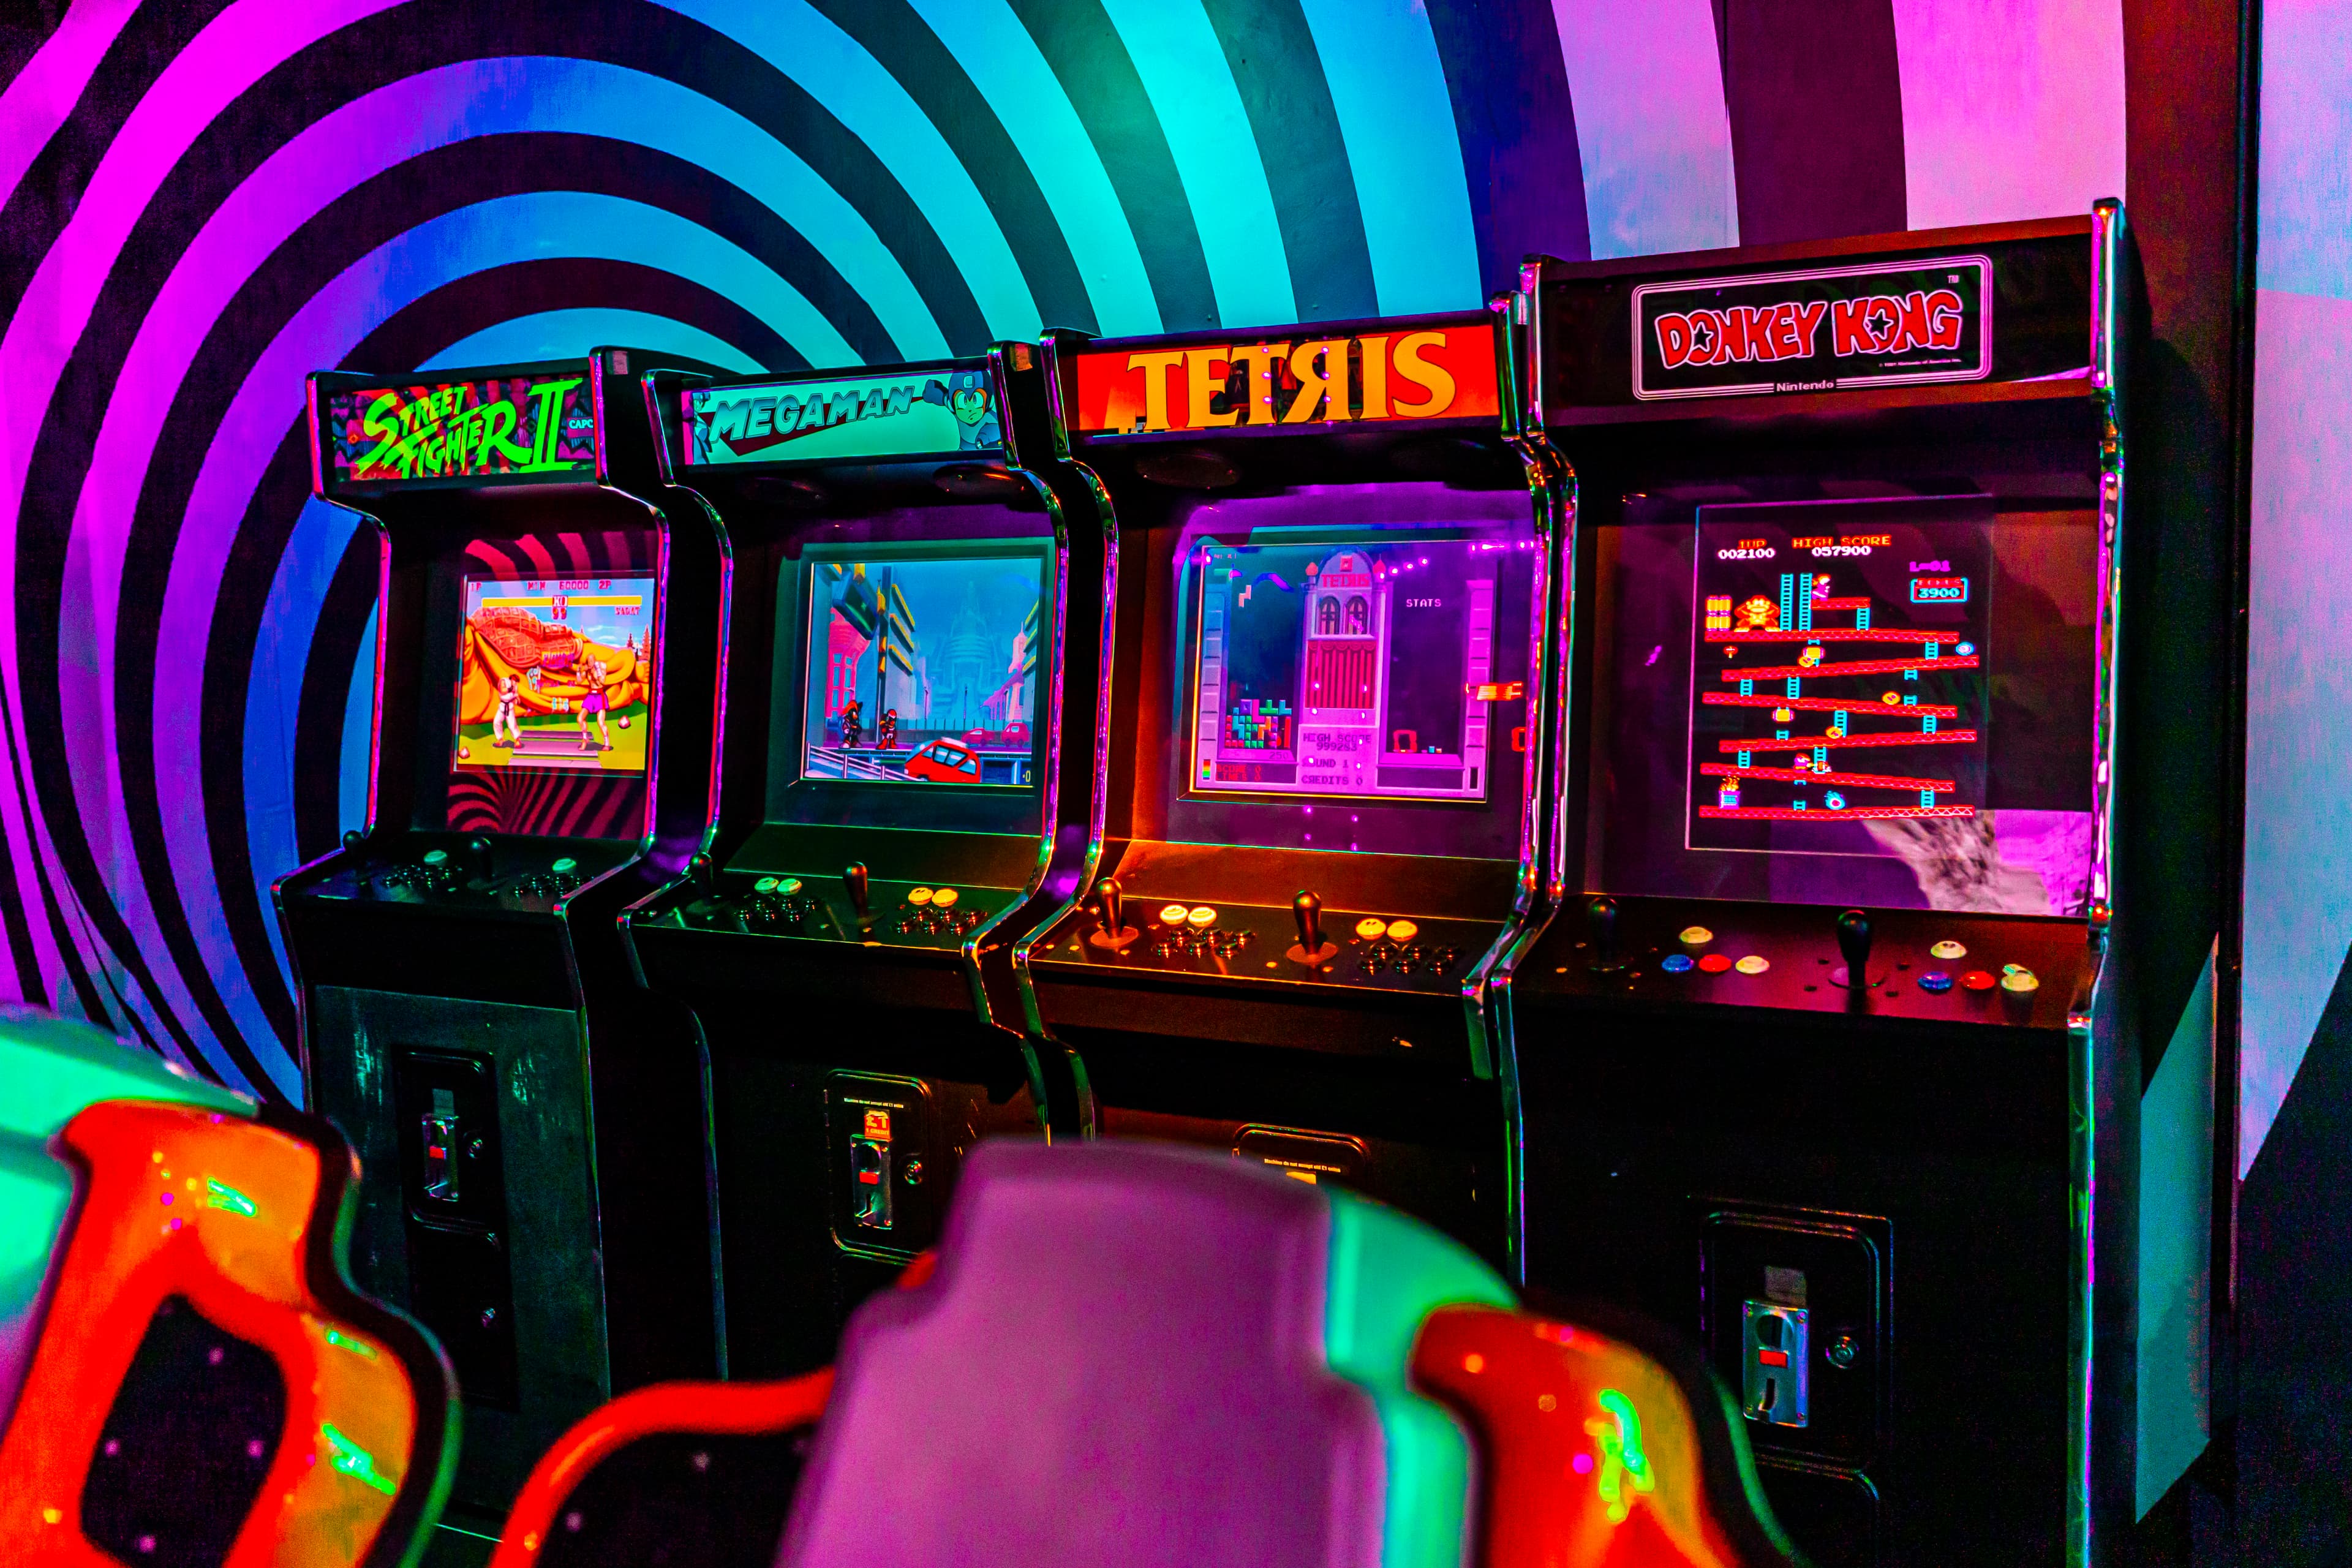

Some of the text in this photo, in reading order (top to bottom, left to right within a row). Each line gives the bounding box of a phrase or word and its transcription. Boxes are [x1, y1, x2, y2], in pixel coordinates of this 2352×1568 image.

[1655, 290, 1963, 369] DONKEY KONG
[1776, 380, 1834, 392] Nintendo
[710, 386, 915, 443] MEGAMAN
[355, 386, 468, 475] STREET
[380, 378, 583, 479] FIGHTER II
[1792, 537, 1834, 548] HIGH
[1841, 534, 1891, 546] SCORE
[1717, 548, 1776, 559] 002100
[1811, 546, 1872, 557] 057900
[1918, 588, 1960, 598] 3900
[1406, 598, 1441, 607] STATS
